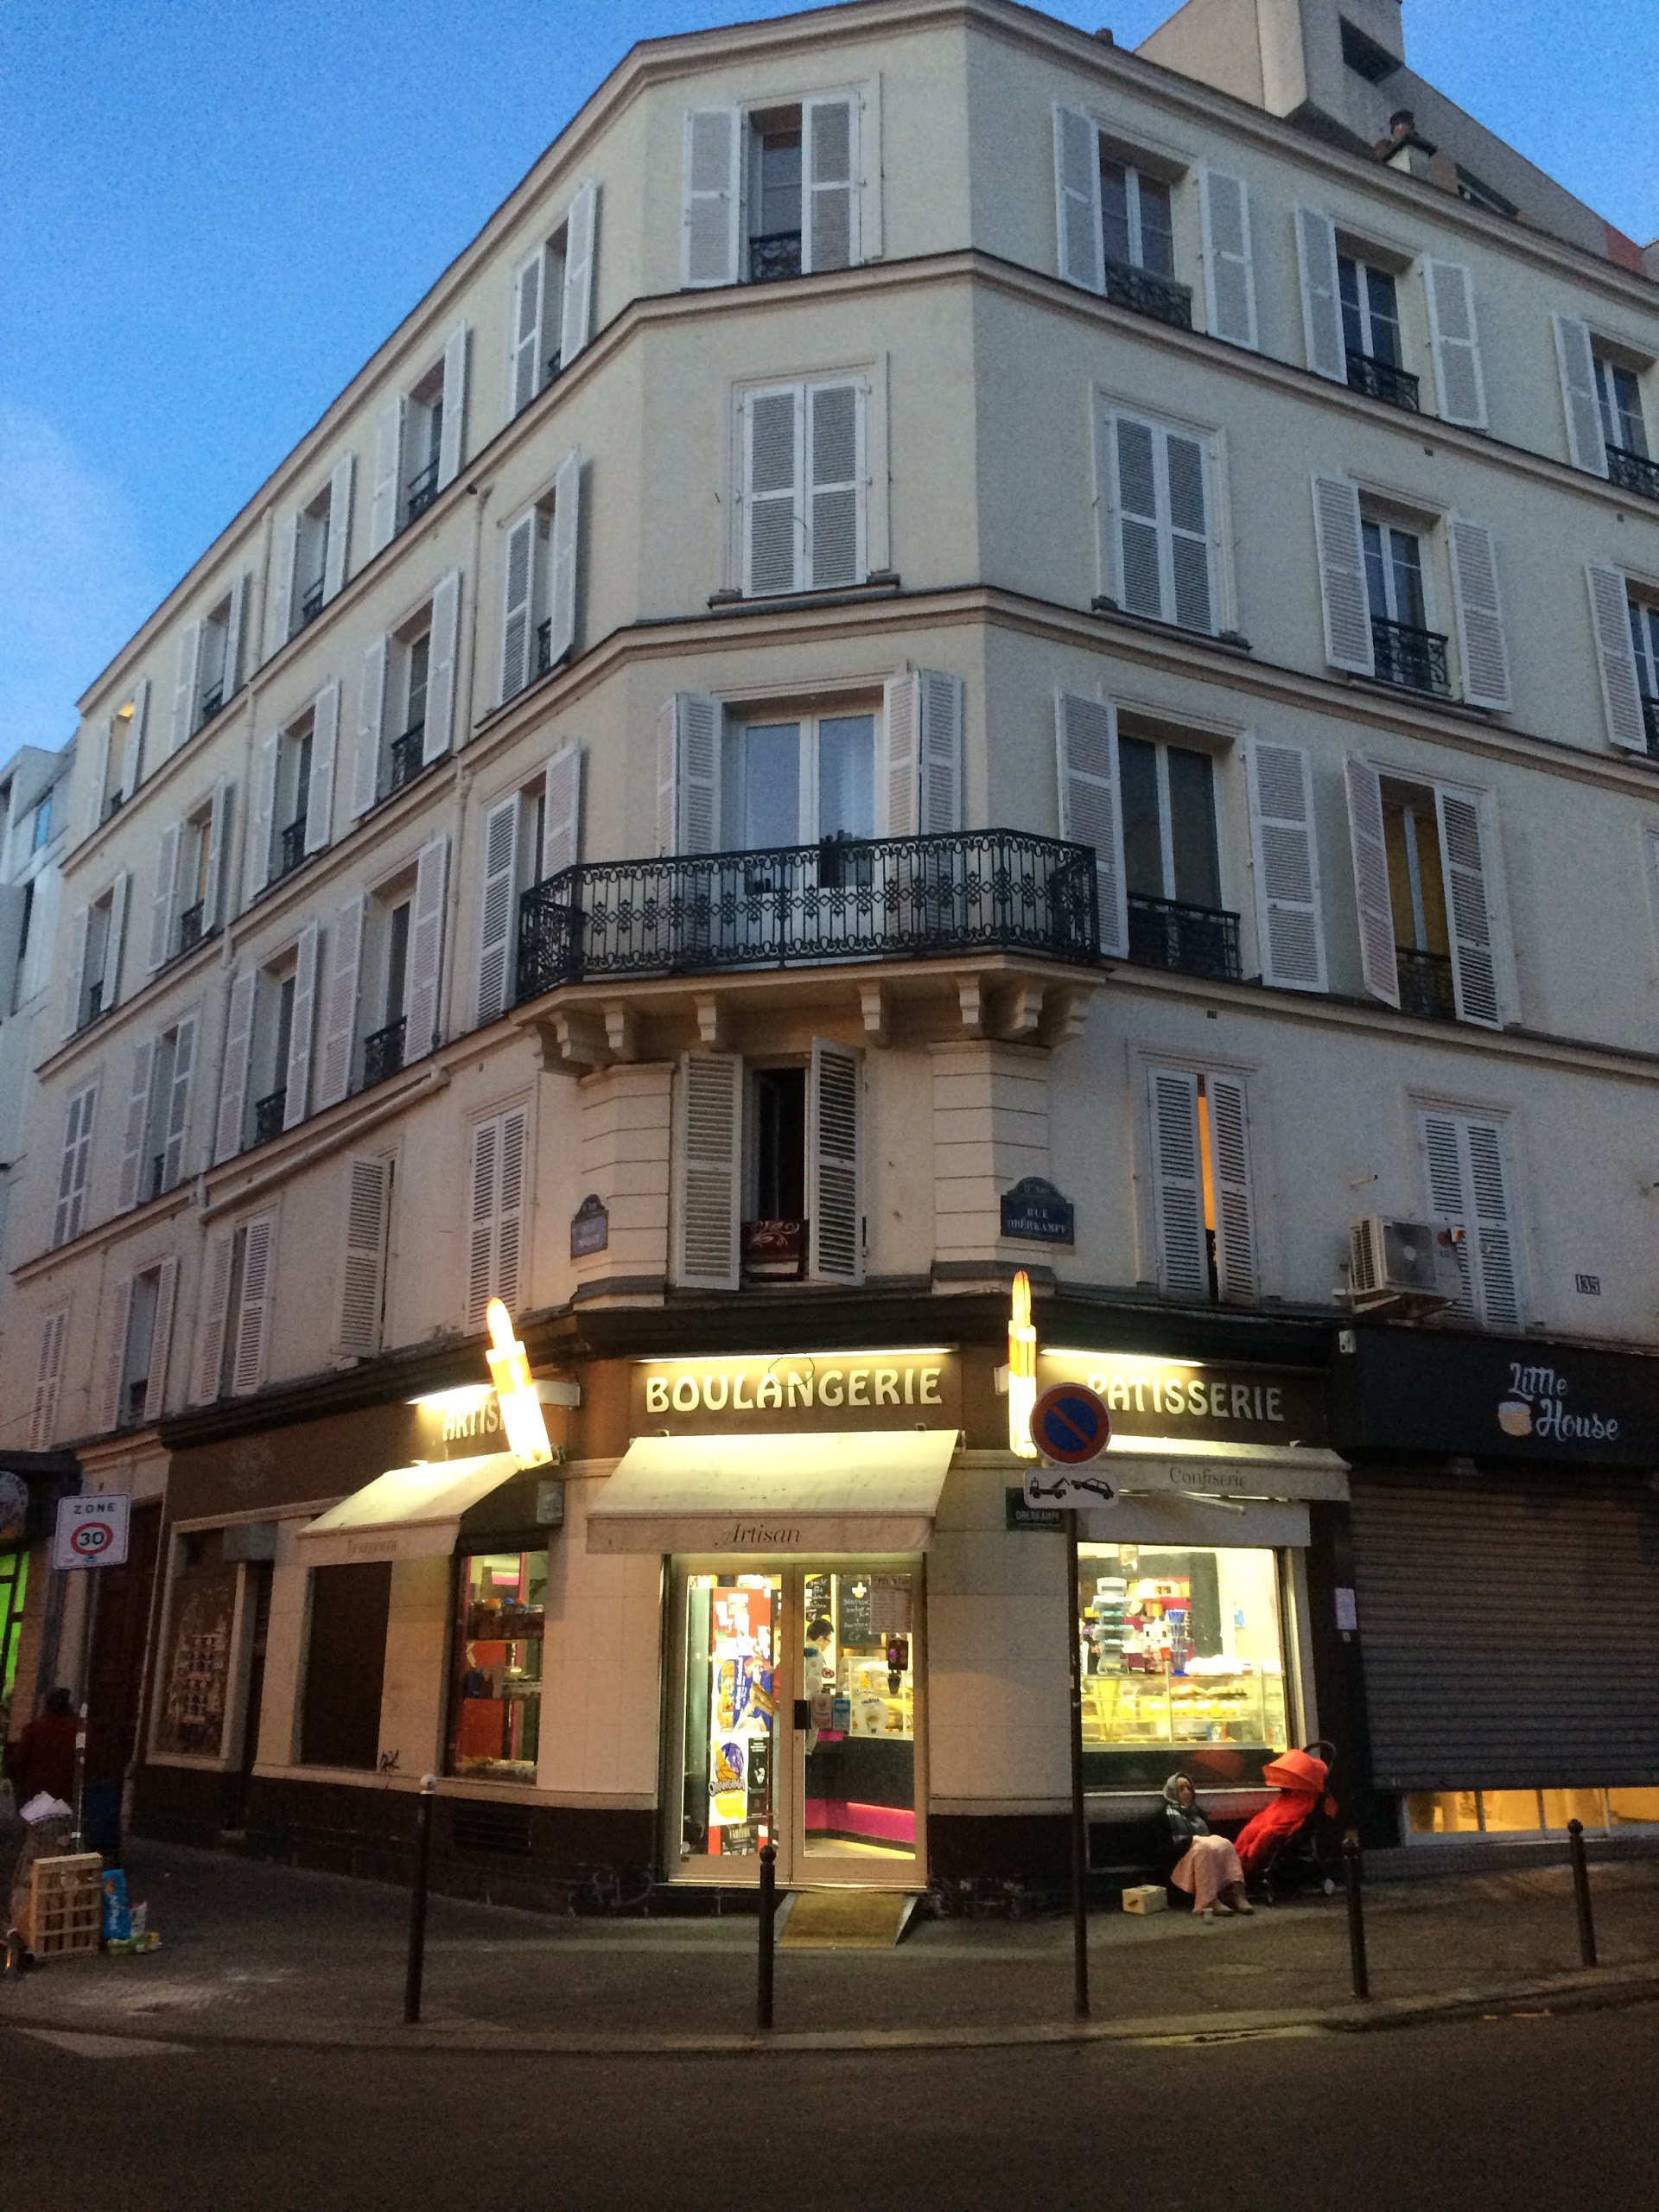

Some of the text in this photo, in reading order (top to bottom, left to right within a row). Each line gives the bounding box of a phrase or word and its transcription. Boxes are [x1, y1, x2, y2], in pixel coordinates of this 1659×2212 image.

[1027, 1208, 1049, 1219] RUE
[1007, 1218, 1067, 1234] OBERKAMPF
[1577, 1274, 1600, 1294] 135
[646, 1368, 944, 1413] BOULANGERIE
[1508, 1363, 1568, 1402] Little
[1087, 1372, 1286, 1422] PATISSERIE
[1535, 1397, 1620, 1442] House
[1169, 1466, 1246, 1490] Confiserie
[73, 1502, 117, 1515] ZONE
[1014, 1510, 1061, 1521] OBERKAMPF
[79, 1531, 105, 1547] 30
[714, 1523, 800, 1548] Artisan
[708, 1778, 747, 1797] ORANGINA
